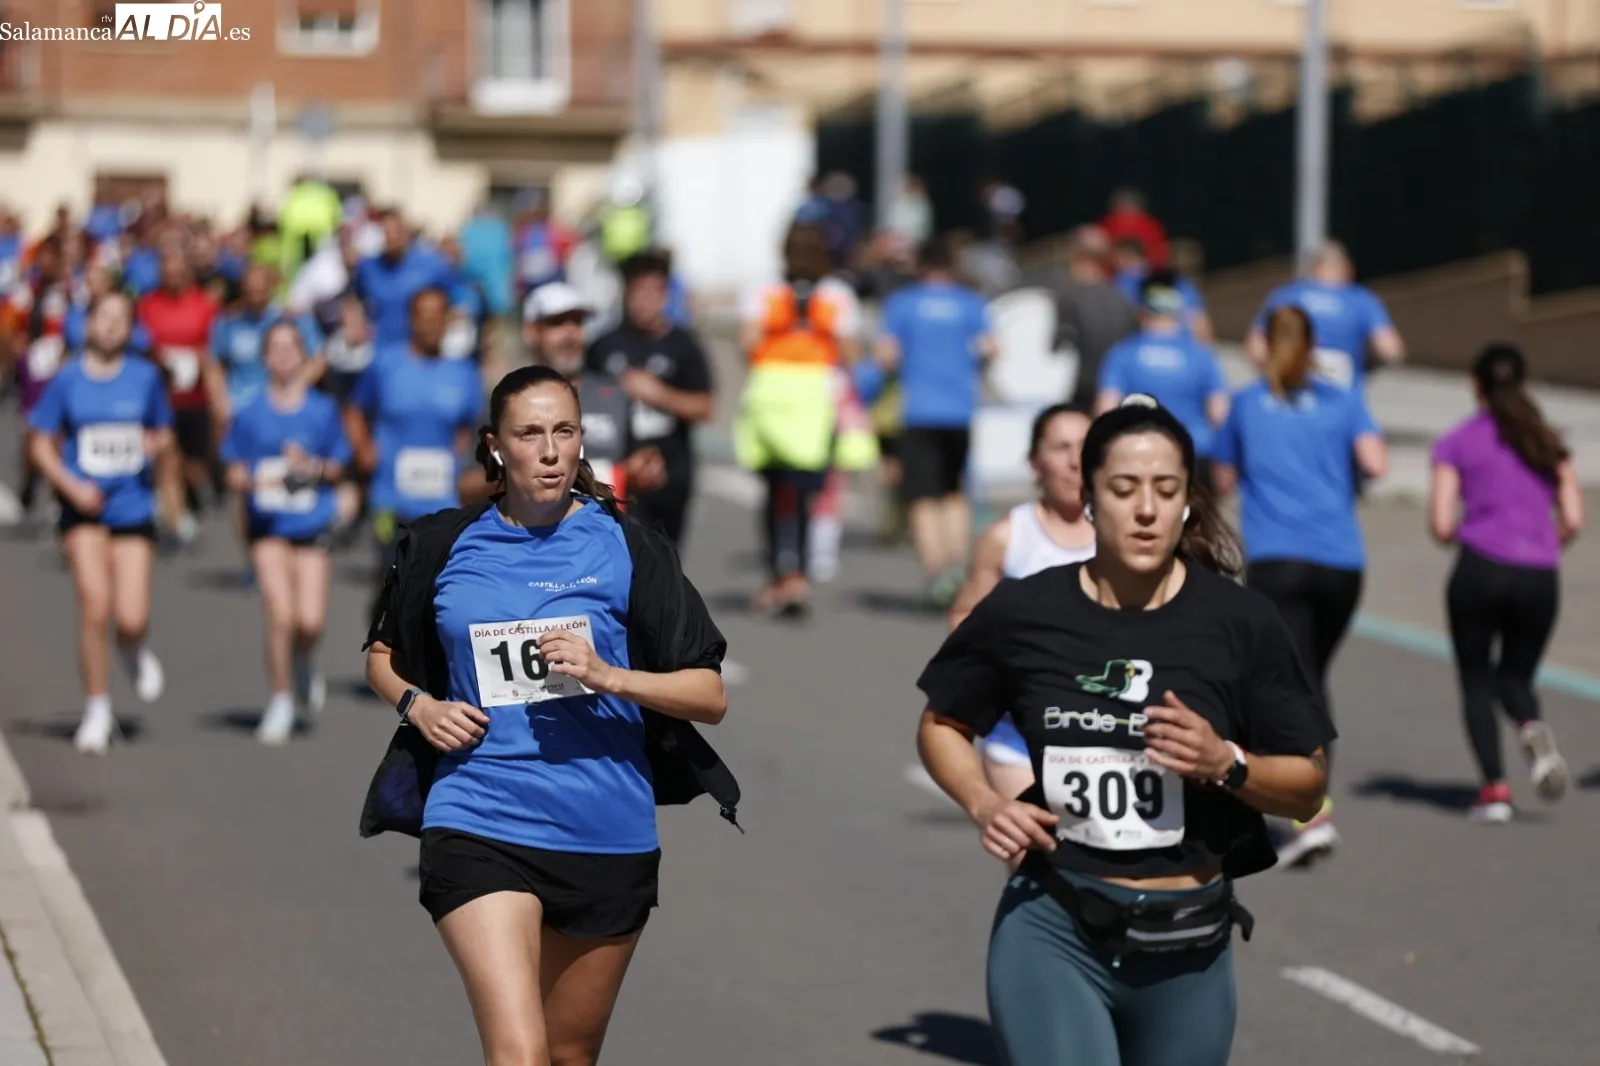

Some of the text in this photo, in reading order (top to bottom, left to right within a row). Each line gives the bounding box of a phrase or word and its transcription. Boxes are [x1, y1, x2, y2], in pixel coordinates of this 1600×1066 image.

[528, 581, 565, 589] CASTILLA
[576, 576, 598, 584] LEÓN
[474, 629, 492, 638] DÍA
[493, 628, 507, 636] DE
[508, 624, 552, 635] CASTILLA
[560, 620, 587, 631] LEÓN
[1063, 769, 1164, 821] 309
